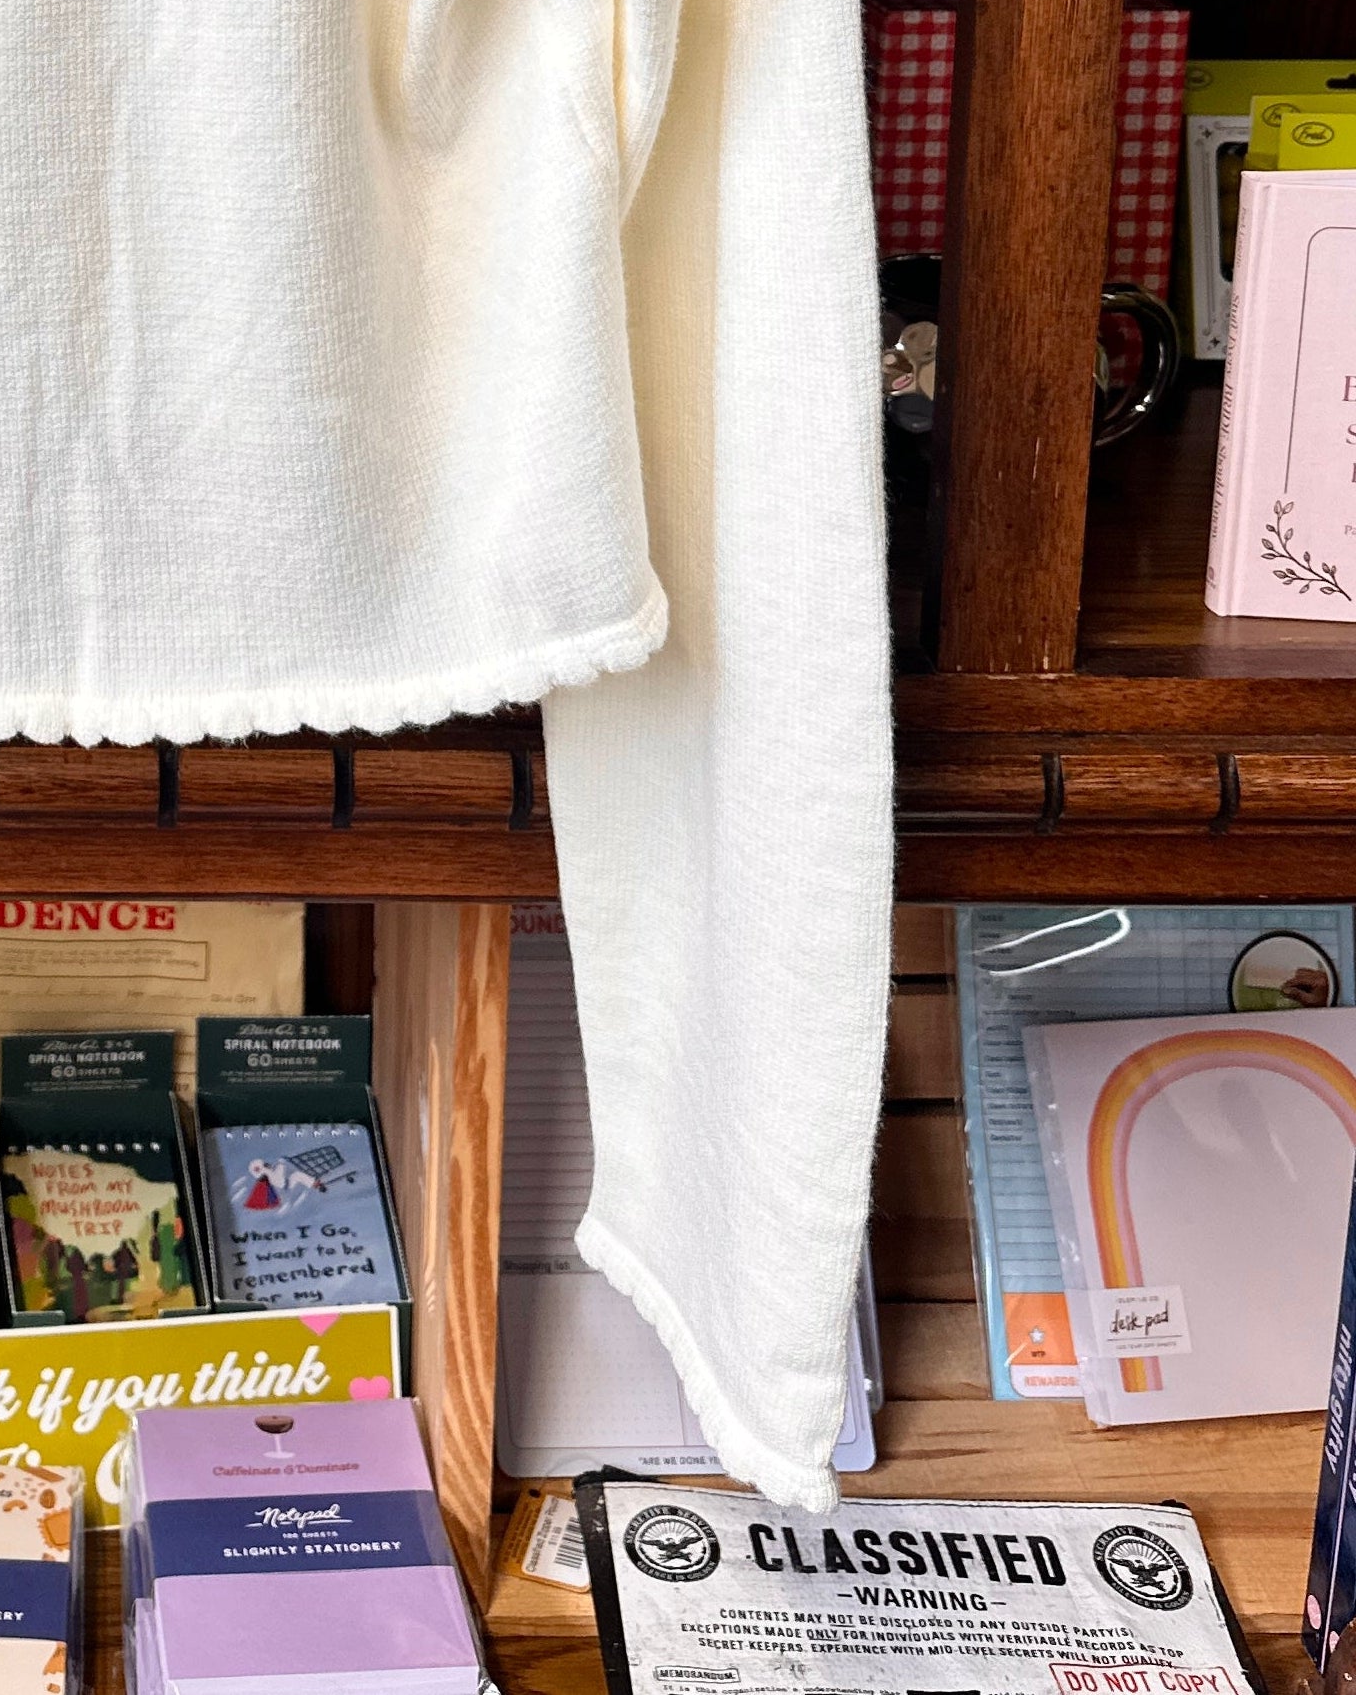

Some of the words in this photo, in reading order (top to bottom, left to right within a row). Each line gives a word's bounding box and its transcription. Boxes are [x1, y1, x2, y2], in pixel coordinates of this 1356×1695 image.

[1220, 383, 1234, 439] BRIDE
[224, 1039, 268, 1050] SPIRAL
[272, 1039, 341, 1051] NOTEBOOK
[28, 1053, 72, 1064] SPIRAL
[76, 1051, 145, 1063] NOTEBOOK
[247, 1054, 272, 1067] 60
[51, 1065, 76, 1078] 60
[32, 1163, 93, 1178] NOTES
[46, 1181, 96, 1196] FROM
[106, 1179, 133, 1194] MY
[40, 1199, 140, 1217] MUSHROOM
[70, 1219, 123, 1237] TRIP
[297, 1225, 311, 1239] I
[233, 1251, 247, 1266] I
[256, 1245, 307, 1262] want
[317, 1243, 336, 1256] to
[342, 1242, 364, 1255] be
[233, 1257, 375, 1291] remembered
[503, 1259, 551, 1274] Shopping
[554, 1258, 570, 1271] list
[245, 1291, 282, 1304] for
[293, 1290, 324, 1302] my
[1110, 1308, 1144, 1334] desk
[1145, 1299, 1169, 1335] pad
[1332, 1322, 1354, 1402] nifty
[27, 1366, 76, 1435] if
[72, 1369, 185, 1434] you
[190, 1345, 331, 1404] think
[1324, 1393, 1344, 1476] gifty
[663, 1456, 677, 1465] WE
[680, 1455, 706, 1465] DONE
[212, 1465, 281, 1477] Caffeinate
[254, 1503, 342, 1530] Notepad
[302, 1531, 339, 1539] SHEETS
[677, 1509, 717, 1544] SERVICE
[223, 1545, 297, 1557] SLIGHTLY
[304, 1541, 401, 1555] STATIONERY
[748, 1522, 1067, 1587] CLASSIFIED
[1094, 1526, 1136, 1561] SECRETIVE
[1143, 1530, 1190, 1572] SERVICE
[720, 1608, 789, 1623] CONTENTS
[794, 1612, 821, 1624] MAY
[828, 1614, 854, 1625] NOT
[859, 1615, 876, 1626] BE
[880, 1616, 953, 1629] DISCLOSED
[958, 1619, 974, 1628] TO
[980, 1620, 1006, 1631] ANY
[1012, 1621, 1067, 1634] OUTSIDE
[681, 1623, 760, 1637] EXCEPTIONS
[765, 1627, 802, 1639] MADE
[806, 1629, 839, 1639] ONLY
[843, 1630, 868, 1640] FOR
[871, 1631, 955, 1642] INDIVIDUALS
[961, 1633, 994, 1643] WITH
[997, 1634, 1071, 1647] VERIFIABLE
[1076, 1639, 1135, 1651] RECORDS
[1140, 1644, 1156, 1653] AS
[1161, 1648, 1184, 1658] TOP
[811, 1643, 887, 1655] EXPERIENCE
[891, 1646, 924, 1656] WITH
[928, 1646, 993, 1656] MID-LEVEL
[999, 1647, 1054, 1659] SECRETS
[1057, 1650, 1088, 1662] WILL
[1092, 1654, 1117, 1665] NOT
[695, 1685, 717, 1694] this
[803, 1686, 875, 1695] understanding
[1064, 1670, 1098, 1693] DO
[1103, 1671, 1151, 1693] NOT
[1159, 1671, 1220, 1695] COPY
